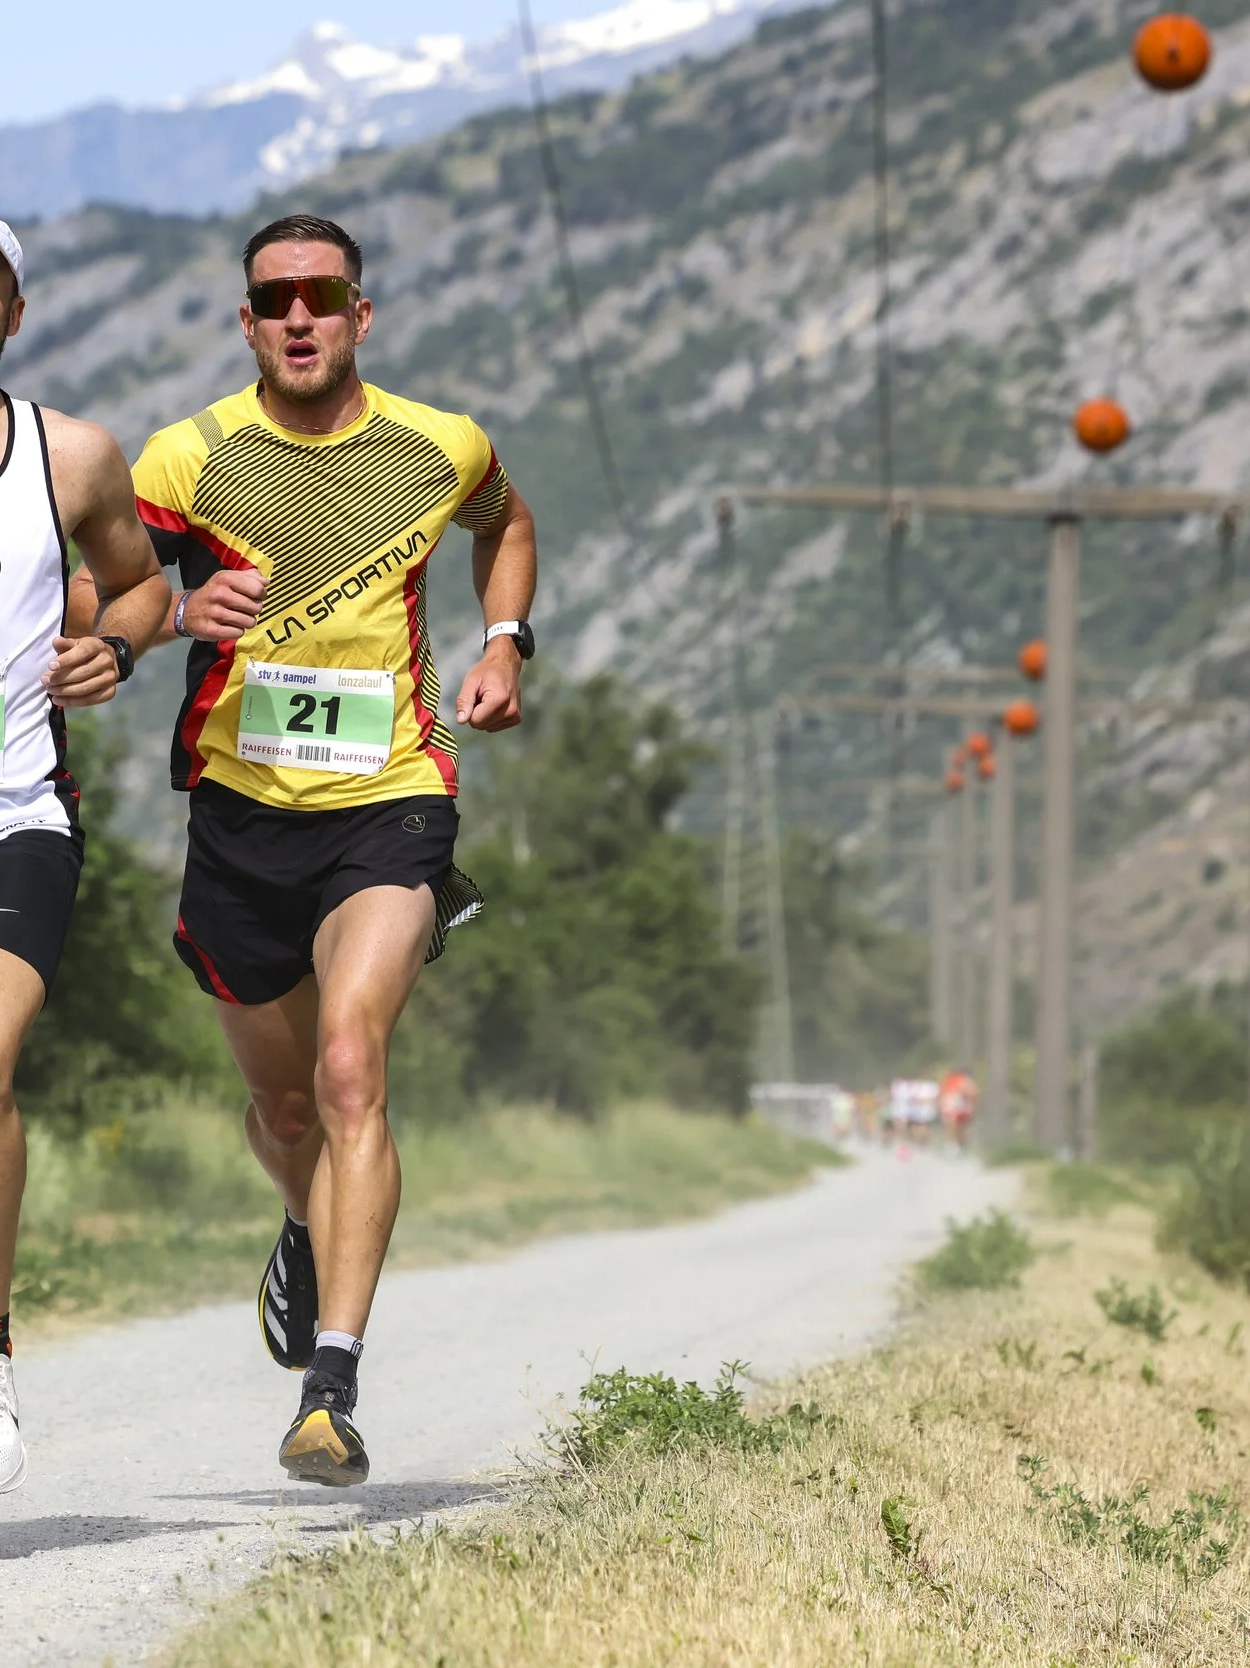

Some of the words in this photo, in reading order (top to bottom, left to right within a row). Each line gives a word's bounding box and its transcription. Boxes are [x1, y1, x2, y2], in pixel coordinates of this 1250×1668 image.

[266, 616, 306, 645] LA
[306, 530, 428, 625] SPORTIVA
[258, 669, 272, 680] stv
[283, 672, 317, 685] gampel
[337, 674, 383, 689] lonzalauf
[286, 693, 341, 735] 21
[242, 742, 292, 756] RAIFFEISEN
[333, 752, 385, 765] RAIFFEISEN
